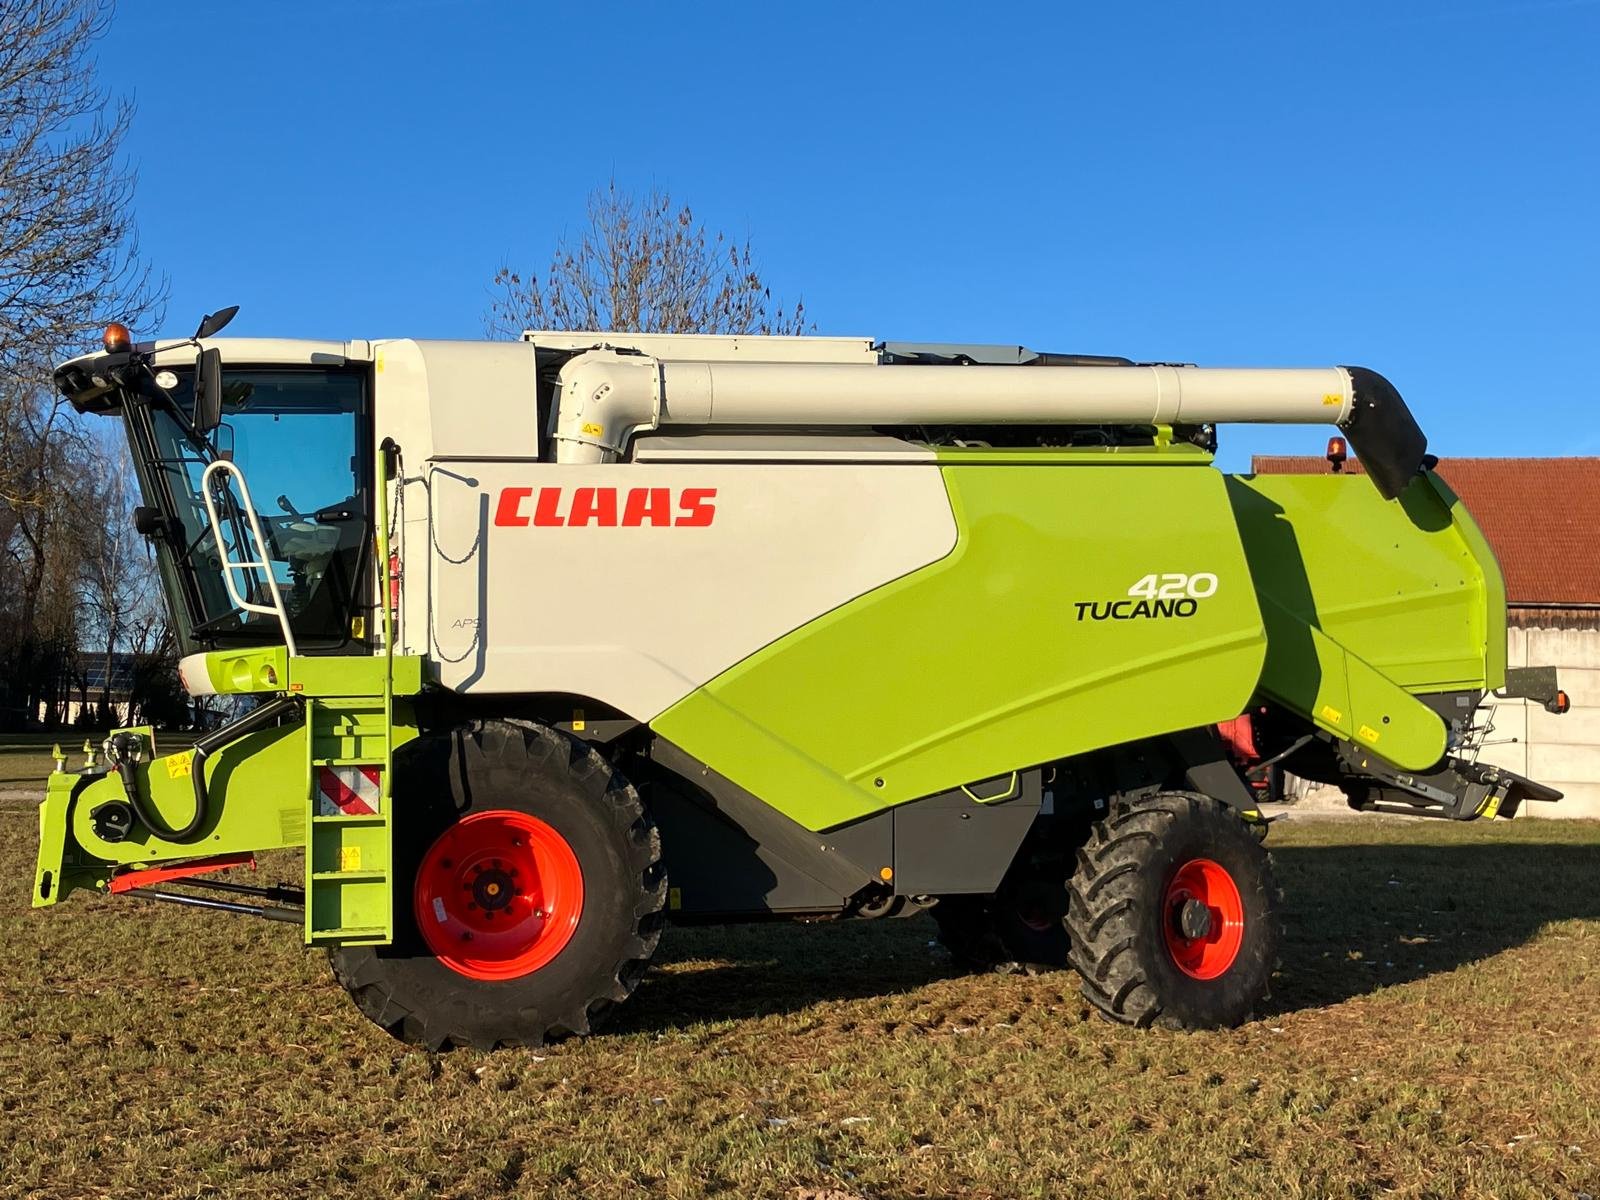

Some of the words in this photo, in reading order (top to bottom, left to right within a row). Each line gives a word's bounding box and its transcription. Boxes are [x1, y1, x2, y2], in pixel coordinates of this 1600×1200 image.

[494, 487, 718, 527] CLAAS
[1127, 572, 1219, 600] 420
[1074, 598, 1198, 621] TUCANO
[451, 618, 481, 628] APS
